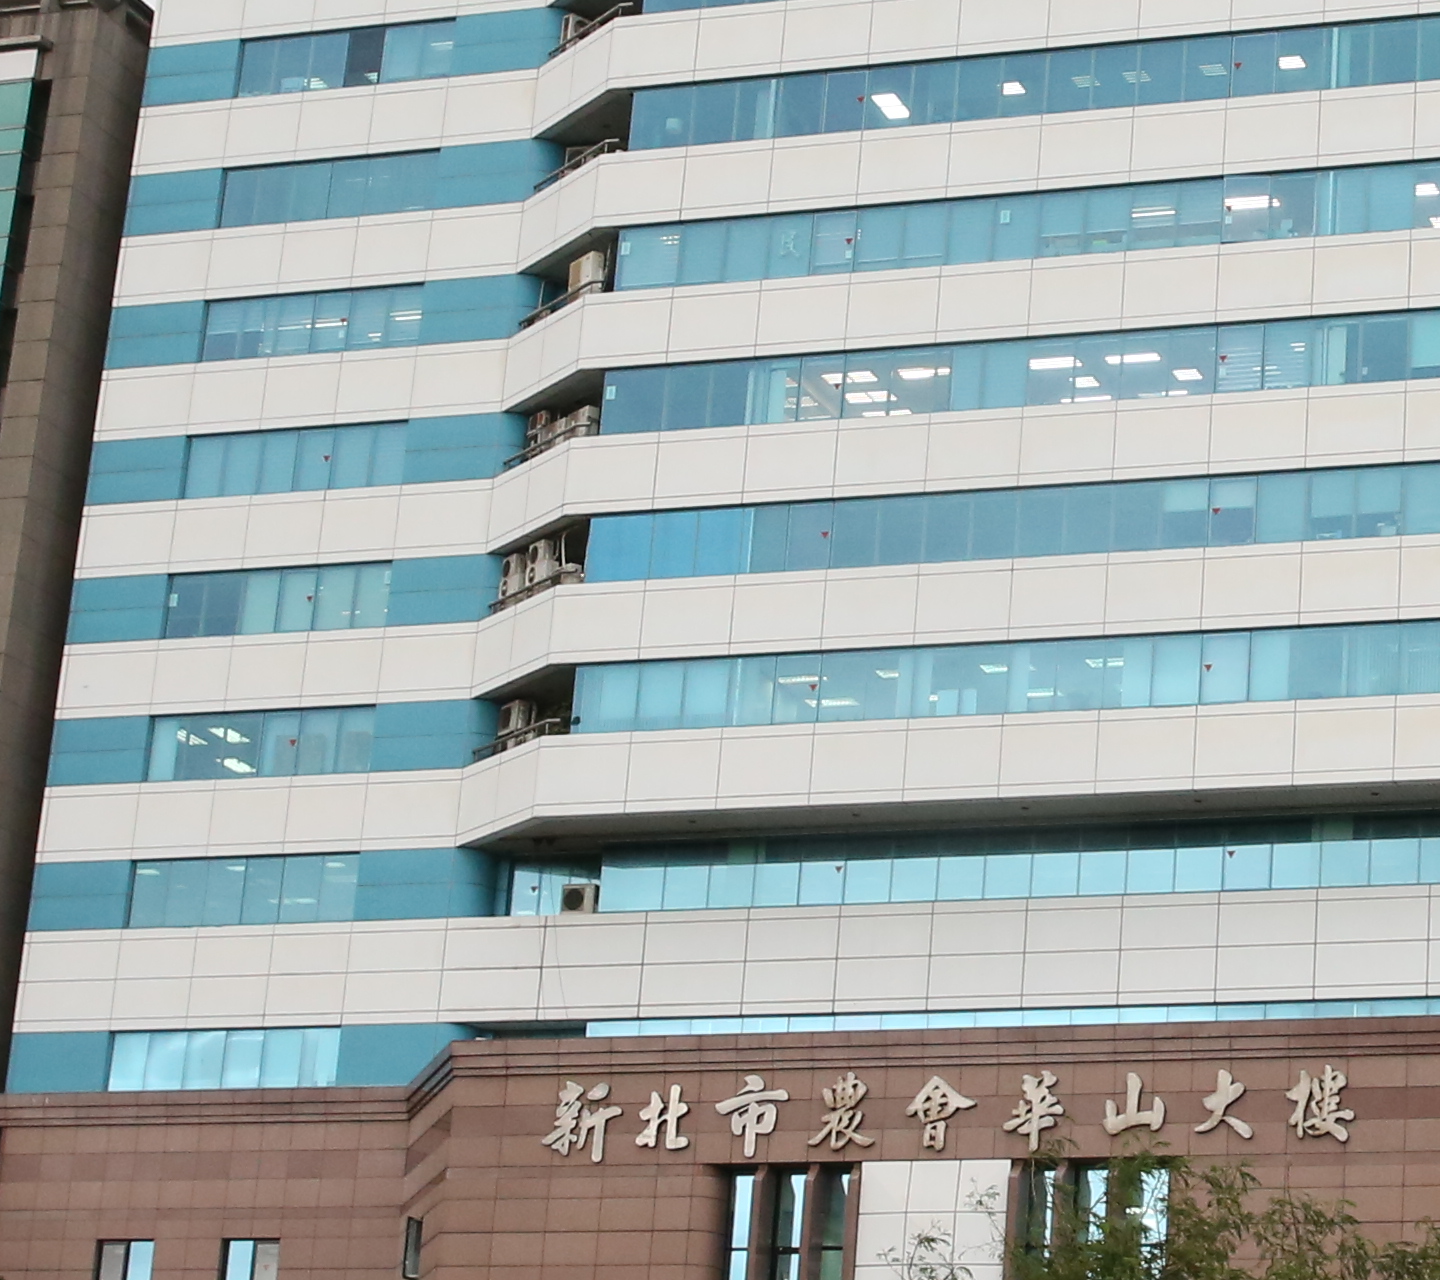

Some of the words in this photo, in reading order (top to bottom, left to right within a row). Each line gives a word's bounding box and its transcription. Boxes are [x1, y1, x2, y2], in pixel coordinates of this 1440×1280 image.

[541, 1063, 1357, 1165] 新北市農會華山大樓
